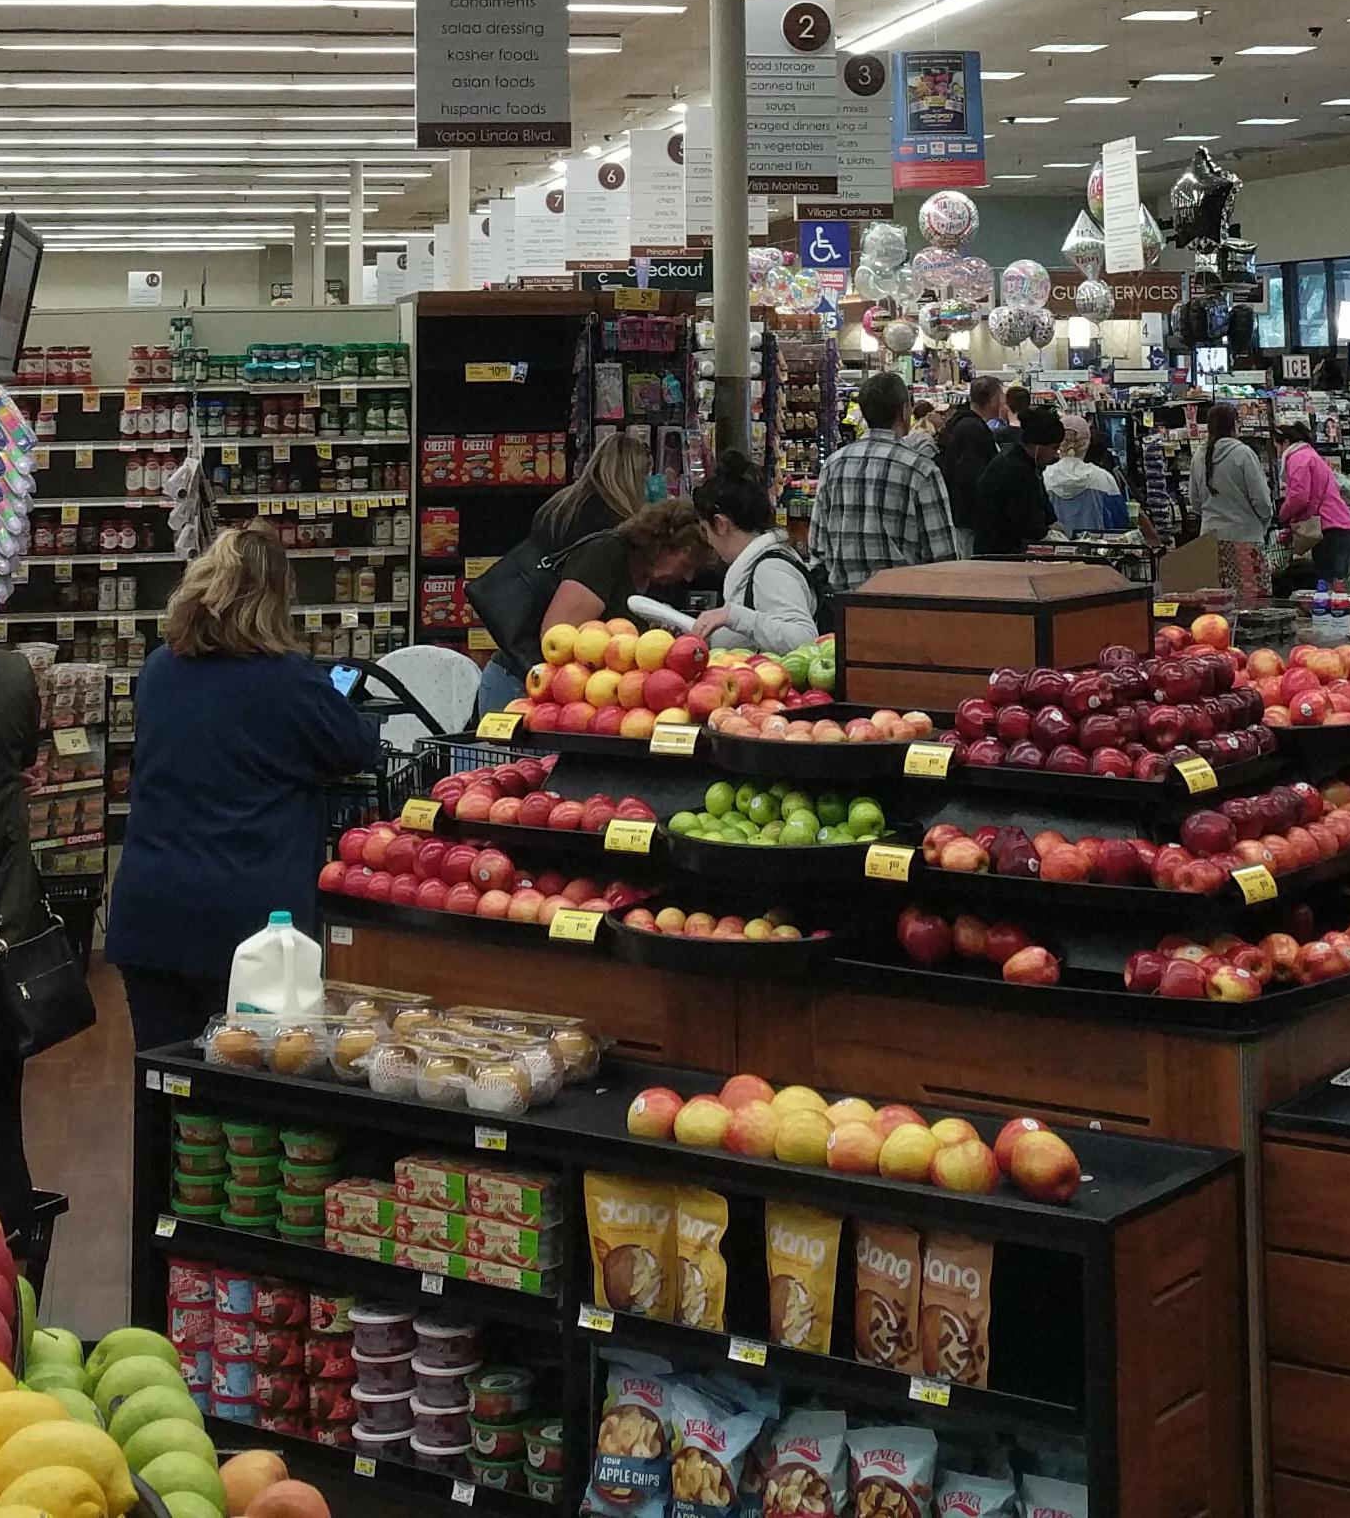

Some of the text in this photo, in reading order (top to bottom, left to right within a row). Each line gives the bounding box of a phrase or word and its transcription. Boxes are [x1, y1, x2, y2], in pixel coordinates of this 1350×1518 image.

[442, 22, 545, 37] salad dressing
[798, 15, 815, 38] 2
[447, 48, 539, 61] kosher foods
[746, 61, 816, 74] food storage
[451, 75, 535, 87] asian foods
[858, 65, 872, 85] 3
[751, 80, 816, 91] canned fruit
[441, 102, 547, 117] hispanic foods
[765, 102, 796, 113] soups
[747, 120, 831, 133] ckaged dinners
[435, 129, 555, 142] Yorba Linda Blvd.
[763, 140, 824, 153] vegetables
[749, 161, 812, 171] canned fish
[606, 171, 617, 183] 6
[771, 181, 819, 192] Montana
[554, 195, 562, 207] 7
[806, 207, 884, 219] Village Center Dr.
[626, 263, 704, 277] ceckout
[1114, 285, 1179, 301] ERVICES
[1285, 358, 1308, 377] ICE
[597, 1196, 671, 1236] dang
[678, 1207, 720, 1248] ang
[769, 1221, 826, 1272] dang
[856, 1236, 912, 1290] dang
[685, 1419, 727, 1448] SENECA
[602, 1457, 621, 1466] SOUR
[859, 1448, 907, 1472] SENECA
[599, 1467, 660, 1487] APPLE CHIPS
